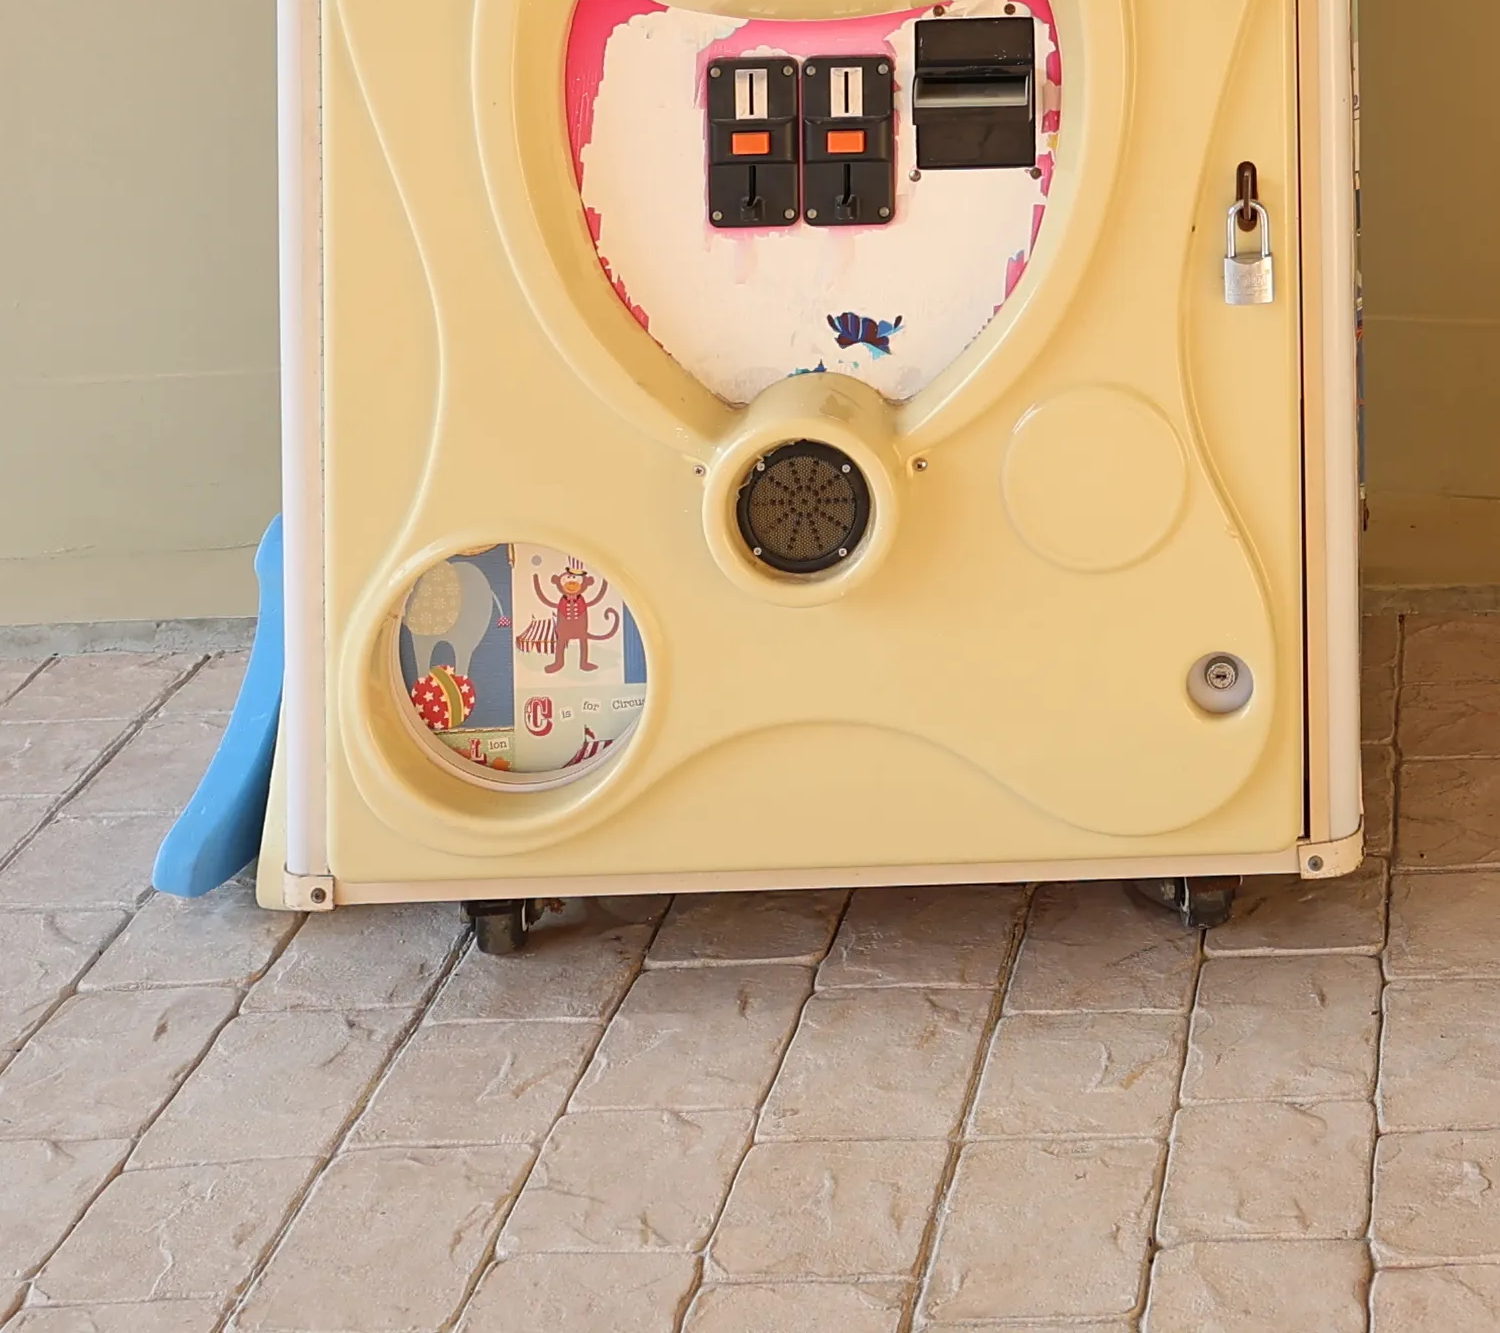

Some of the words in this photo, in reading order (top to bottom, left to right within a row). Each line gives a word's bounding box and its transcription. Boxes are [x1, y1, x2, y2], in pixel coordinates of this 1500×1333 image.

[524, 696, 554, 737] C
[561, 709, 572, 719] is
[583, 701, 600, 712] for
